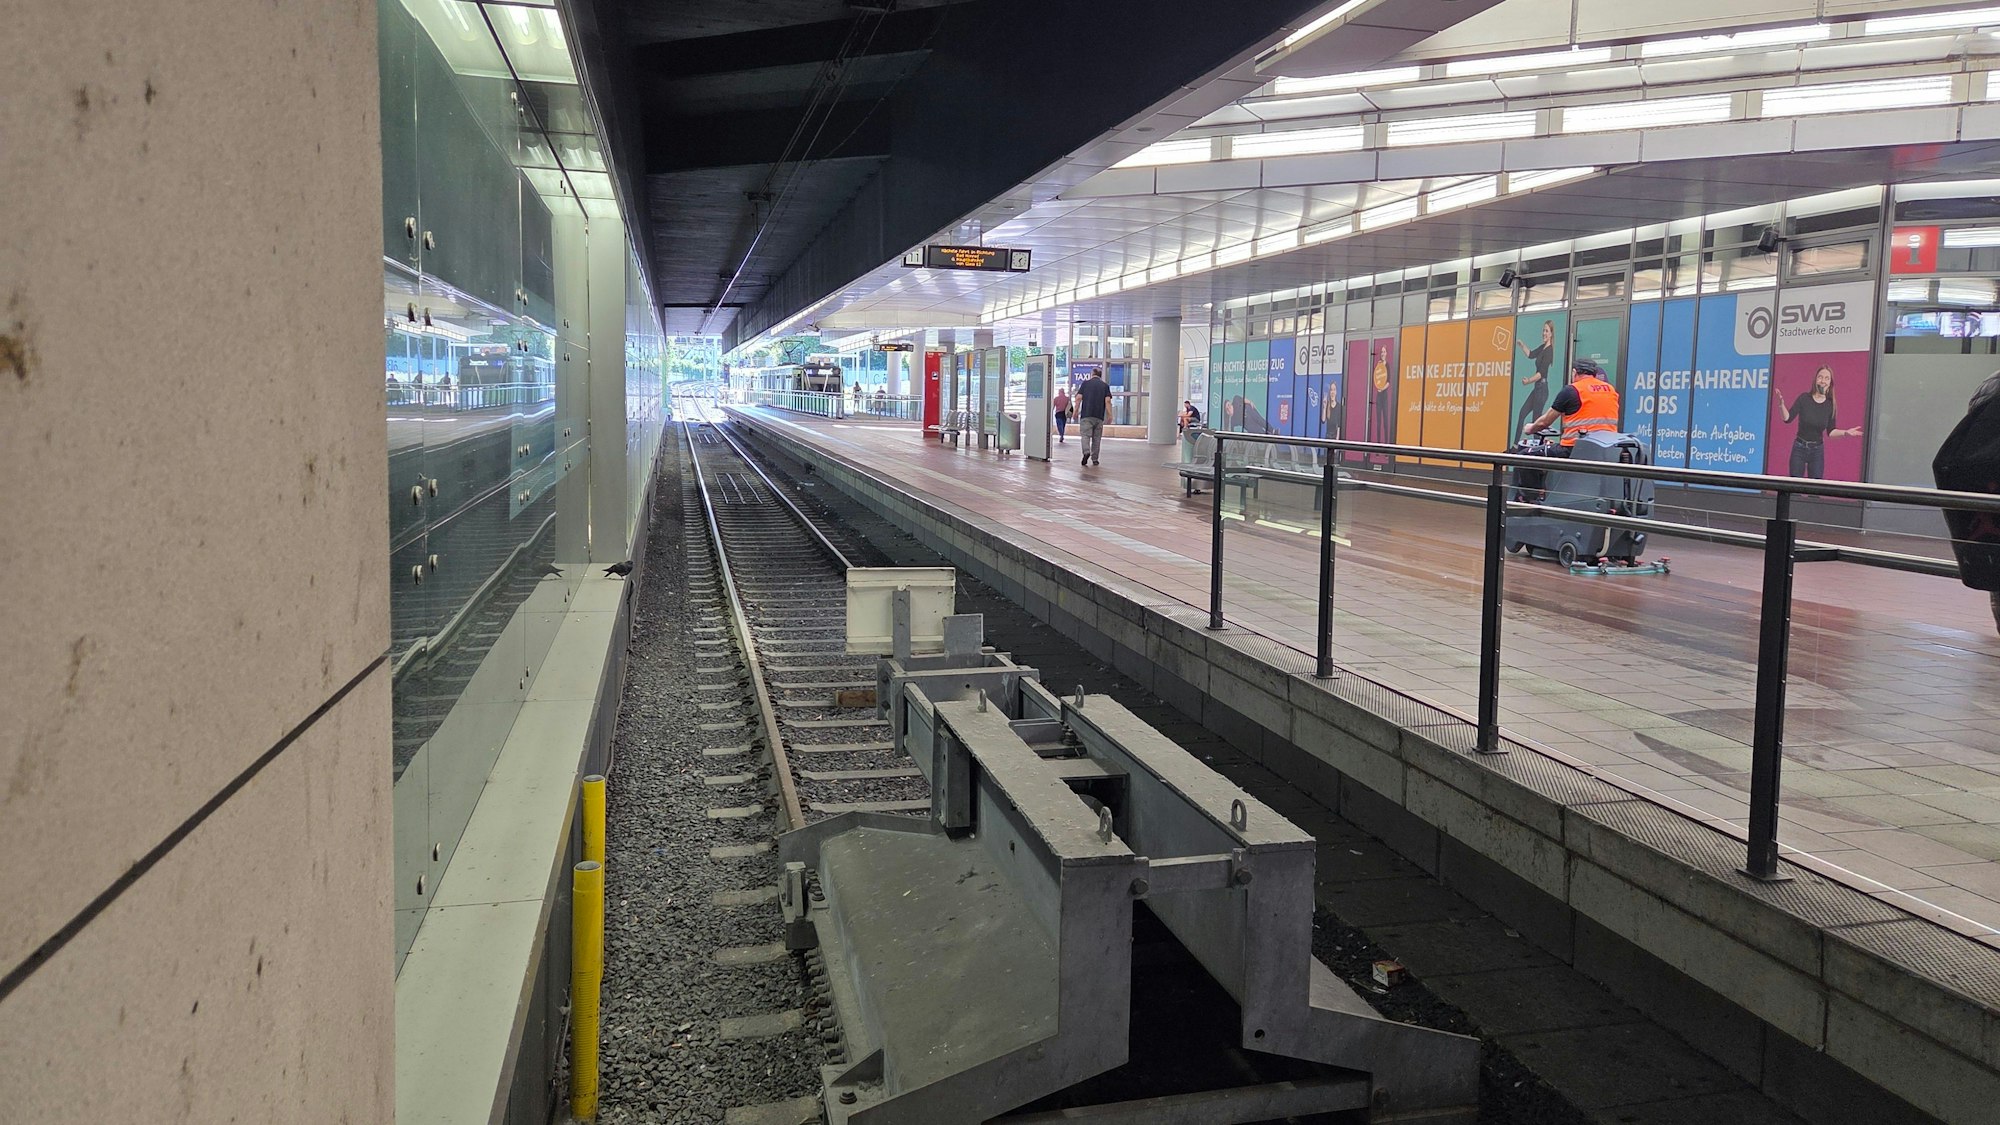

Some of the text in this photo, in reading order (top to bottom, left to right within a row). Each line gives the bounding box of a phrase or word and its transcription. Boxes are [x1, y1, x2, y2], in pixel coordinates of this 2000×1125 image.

[1781, 301, 1846, 324] SWB
[1780, 324, 1852, 337] Stadtwerke Bonn
[1311, 345, 1335, 356] SWB
[1213, 362, 1224, 373] EIN
[1224, 360, 1245, 372] RICHTIG
[1270, 358, 1285, 370] ZUG
[1407, 362, 1511, 379] LENKE JETZT DEINE
[1074, 373, 1090, 381] TAXI
[1634, 368, 1769, 390] ABGEFAHRENE
[1436, 382, 1489, 397] ZUKUNFT
[1636, 395, 1678, 414] JOBS
[1709, 423, 1755, 445] Aufgaben
[1657, 444, 1685, 460] besten
